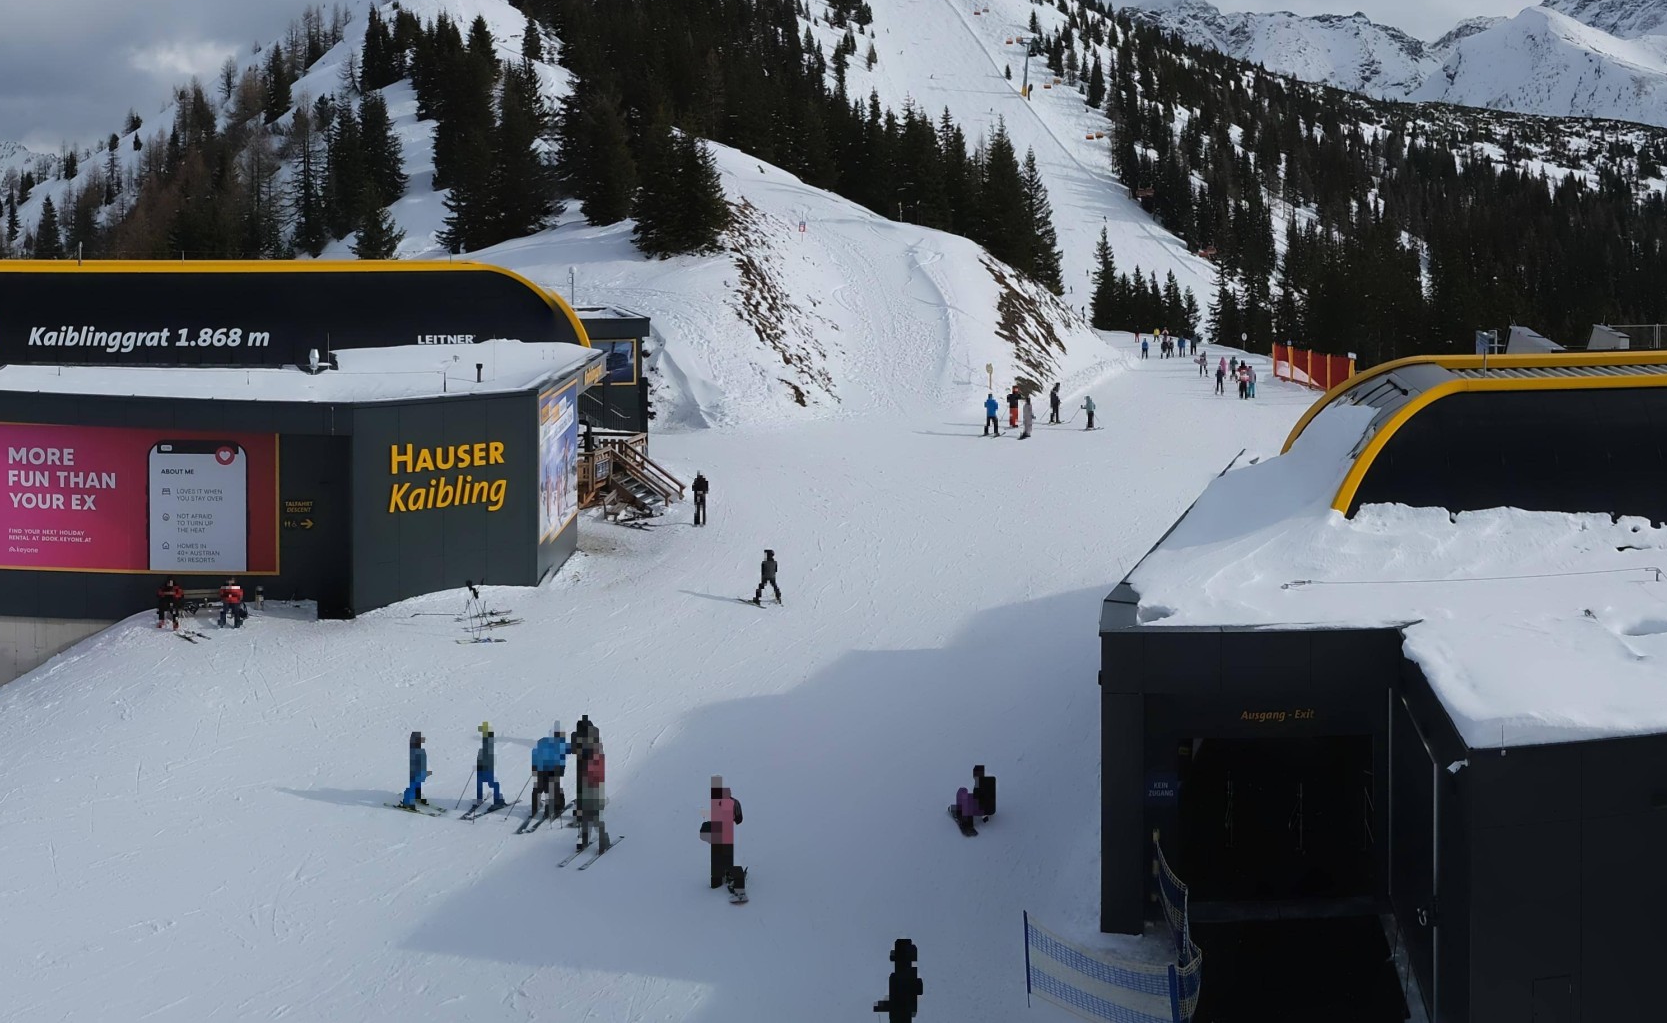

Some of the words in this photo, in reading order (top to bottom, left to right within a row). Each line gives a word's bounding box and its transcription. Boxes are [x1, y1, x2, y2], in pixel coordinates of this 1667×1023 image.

[28, 326, 169, 352] Kaiblinggrat
[175, 327, 242, 347] 1.868
[247, 331, 270, 347] m
[417, 334, 474, 345] LEITNER
[8, 447, 74, 465] MORE
[390, 441, 505, 475] HAUSER
[8, 470, 49, 487] FUN
[56, 471, 116, 489] THAN
[9, 492, 65, 510] YOUR
[71, 494, 96, 511] EX
[389, 475, 507, 513] Kaibling
[16, 546, 39, 554] keyone
[1241, 709, 1285, 722] Ausgang
[1295, 709, 1315, 719] Exit
